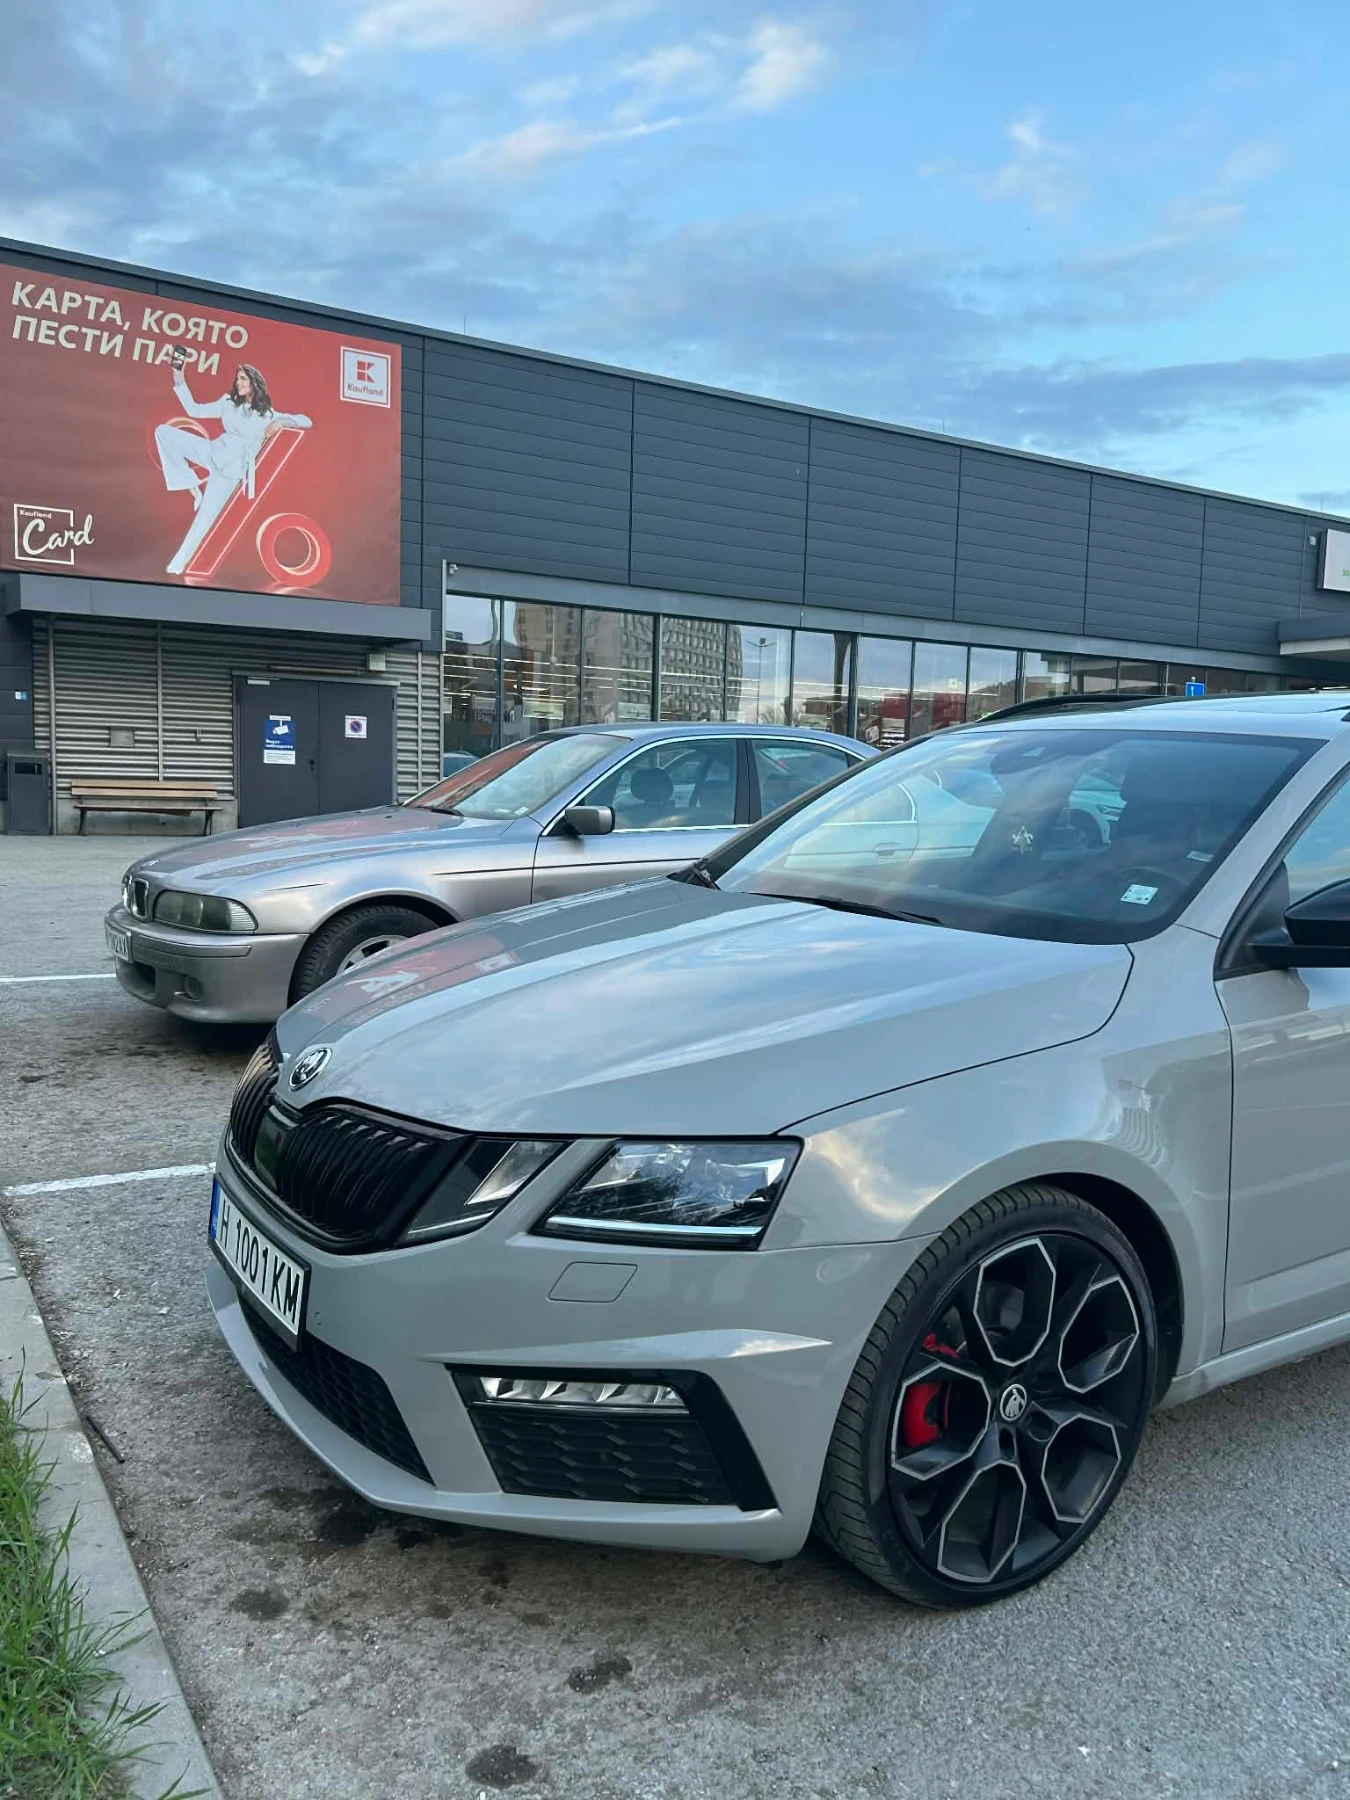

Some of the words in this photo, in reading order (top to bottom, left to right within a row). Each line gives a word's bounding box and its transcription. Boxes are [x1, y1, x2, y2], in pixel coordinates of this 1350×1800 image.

[11, 280, 131, 331] КАРТА,
[141, 307, 249, 349] КОЯТО
[12, 314, 124, 358] ПЕСТИ
[347, 382, 384, 396] Kaufland
[20, 509, 52, 519] Kaufland
[23, 514, 95, 555] Card
